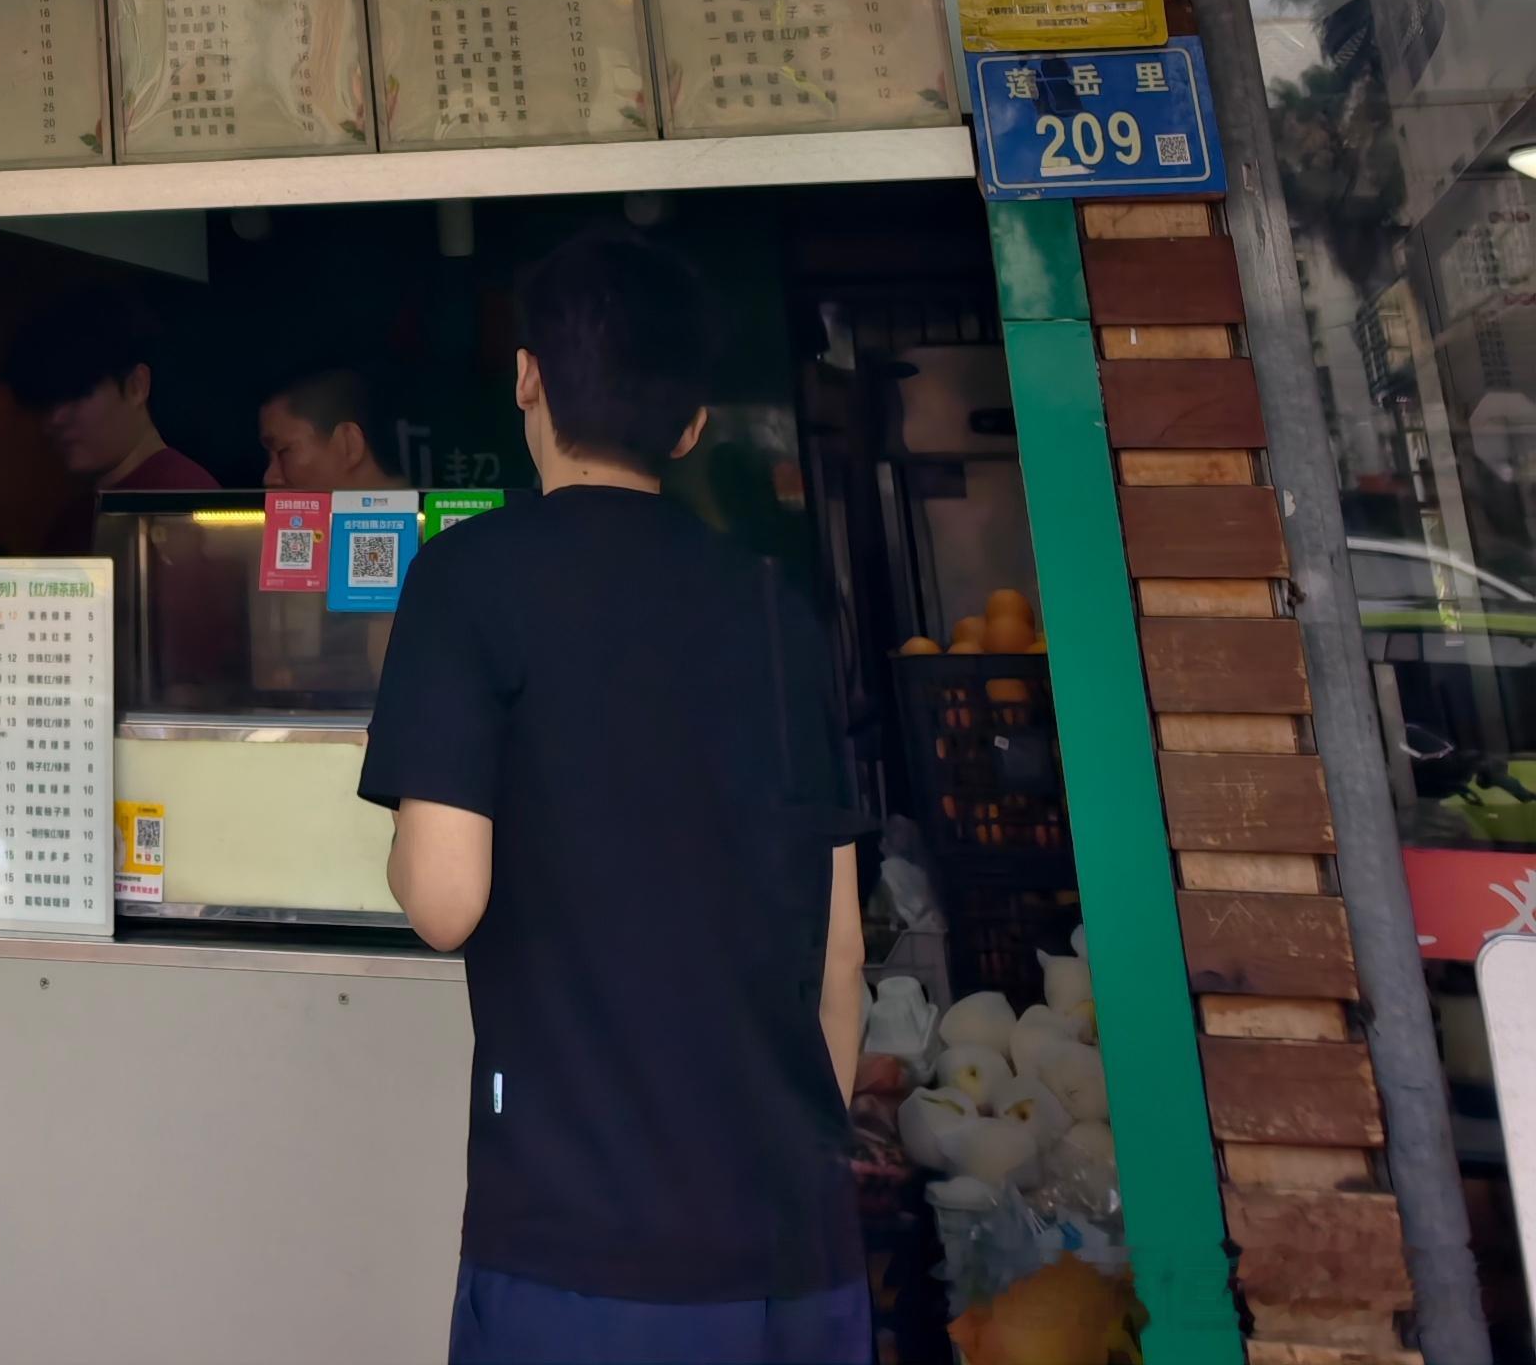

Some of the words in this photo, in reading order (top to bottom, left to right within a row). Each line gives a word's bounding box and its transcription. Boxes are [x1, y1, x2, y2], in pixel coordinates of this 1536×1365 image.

[1004, 61, 1171, 102] 莲岳里
[1035, 110, 1143, 168] 209
